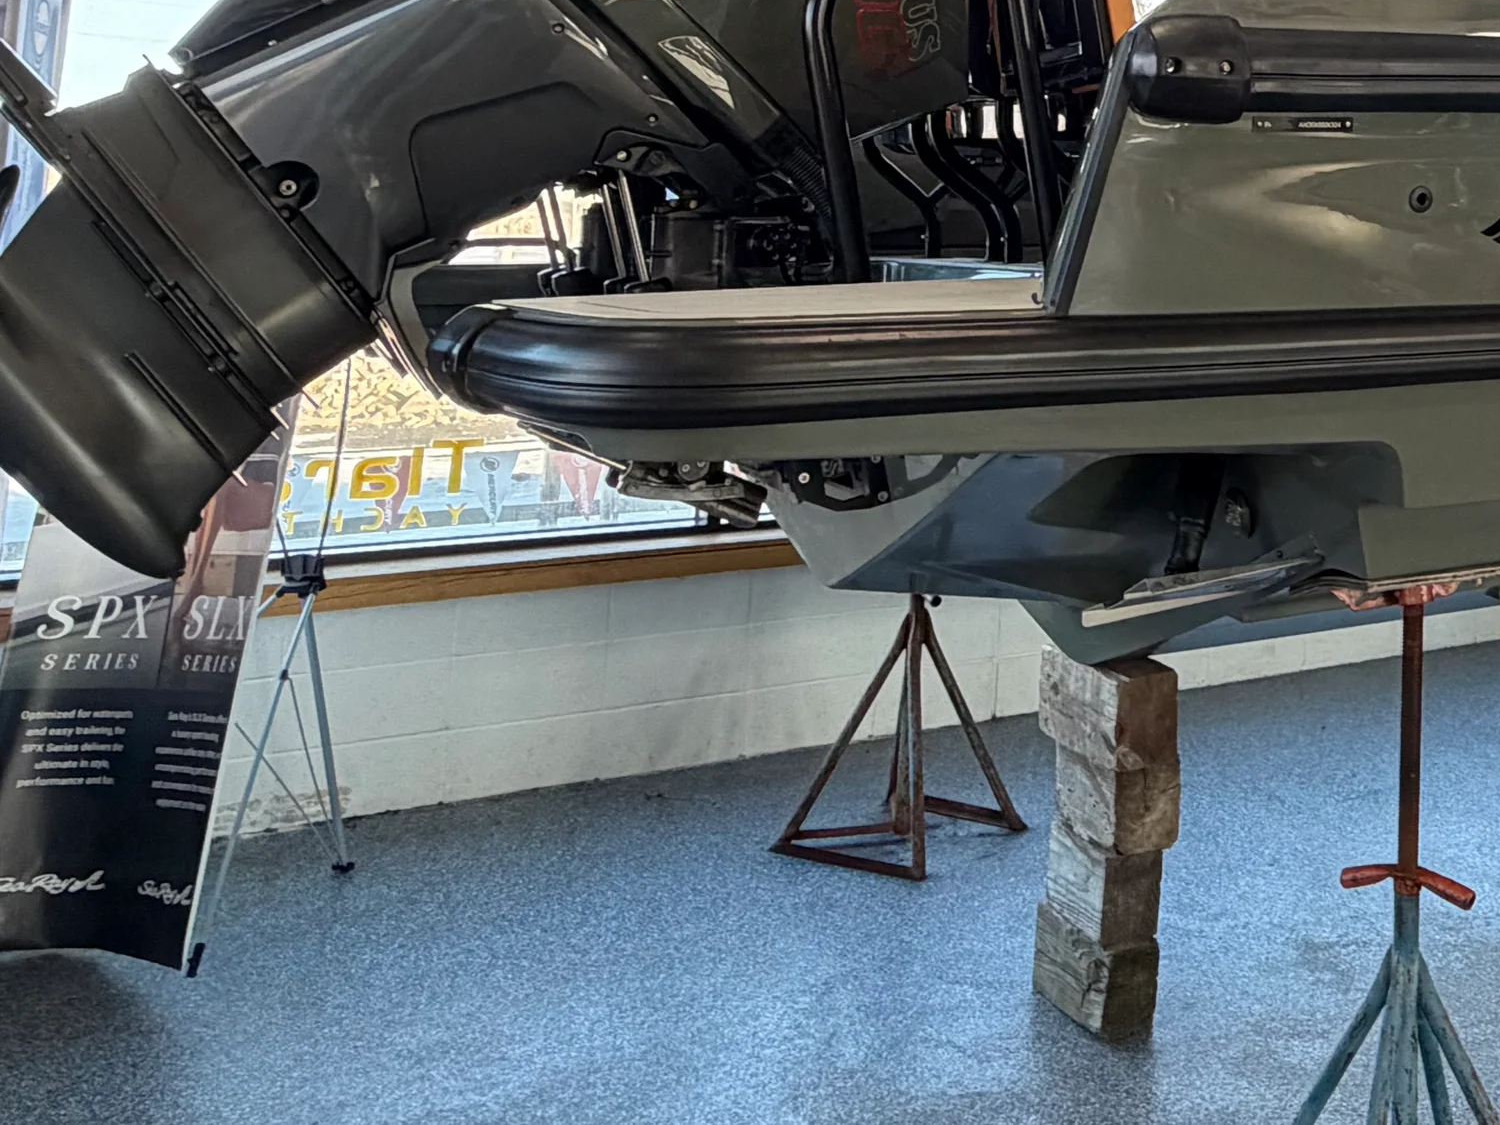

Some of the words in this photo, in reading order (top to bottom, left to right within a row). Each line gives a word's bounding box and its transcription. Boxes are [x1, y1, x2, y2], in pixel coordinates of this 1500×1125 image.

[36, 594, 159, 640] SPX
[182, 594, 253, 641] SLX
[40, 652, 140, 671] SERIES
[181, 654, 237, 674] SERIES
